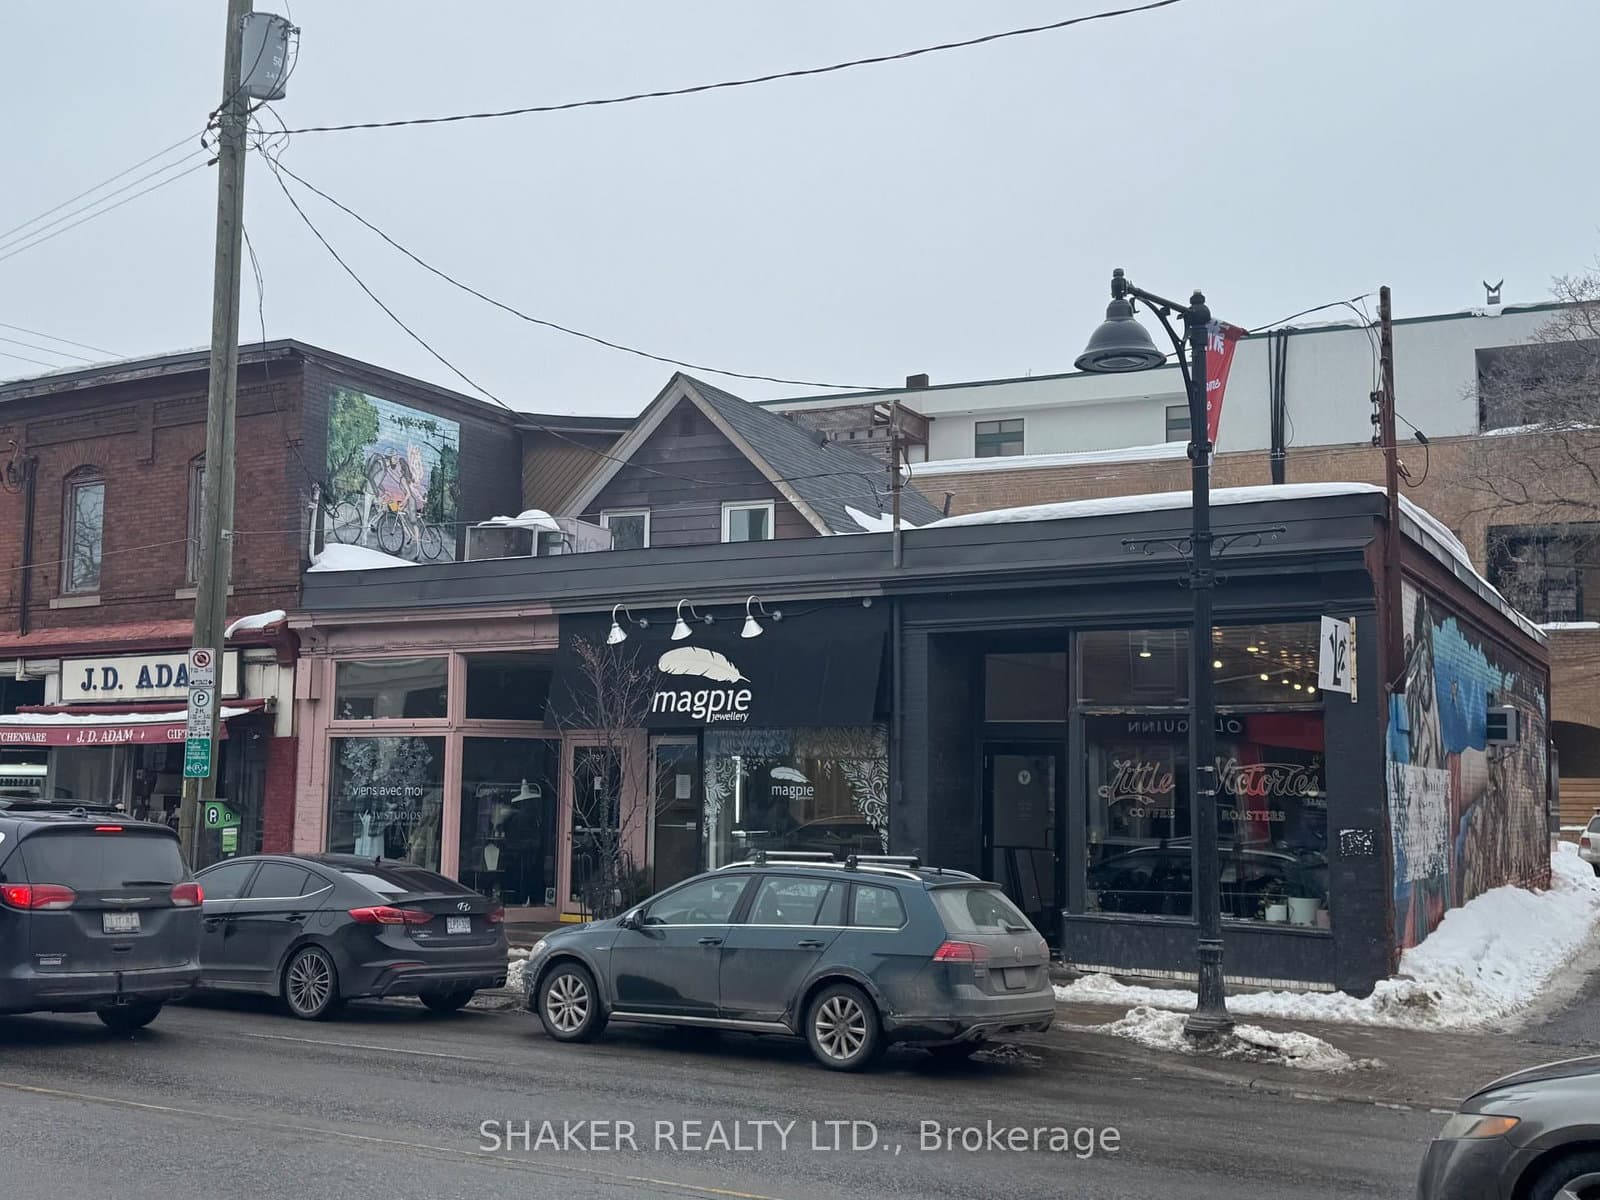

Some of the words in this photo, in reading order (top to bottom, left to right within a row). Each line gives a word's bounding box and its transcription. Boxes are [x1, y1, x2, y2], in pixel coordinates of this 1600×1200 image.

[136, 663, 190, 688] ADA
[652, 689, 752, 723] magpie
[711, 712, 749, 722] jewellery
[0, 732, 47, 742] CHENWARE
[101, 729, 133, 742] ADAM
[1098, 760, 1176, 807] Little
[1215, 756, 1320, 797] Victories
[353, 785, 377, 796] viens
[380, 786, 402, 796] avec
[404, 785, 423, 796] moi
[771, 785, 814, 800] magpie
[1221, 810, 1286, 821] ROASTERS
